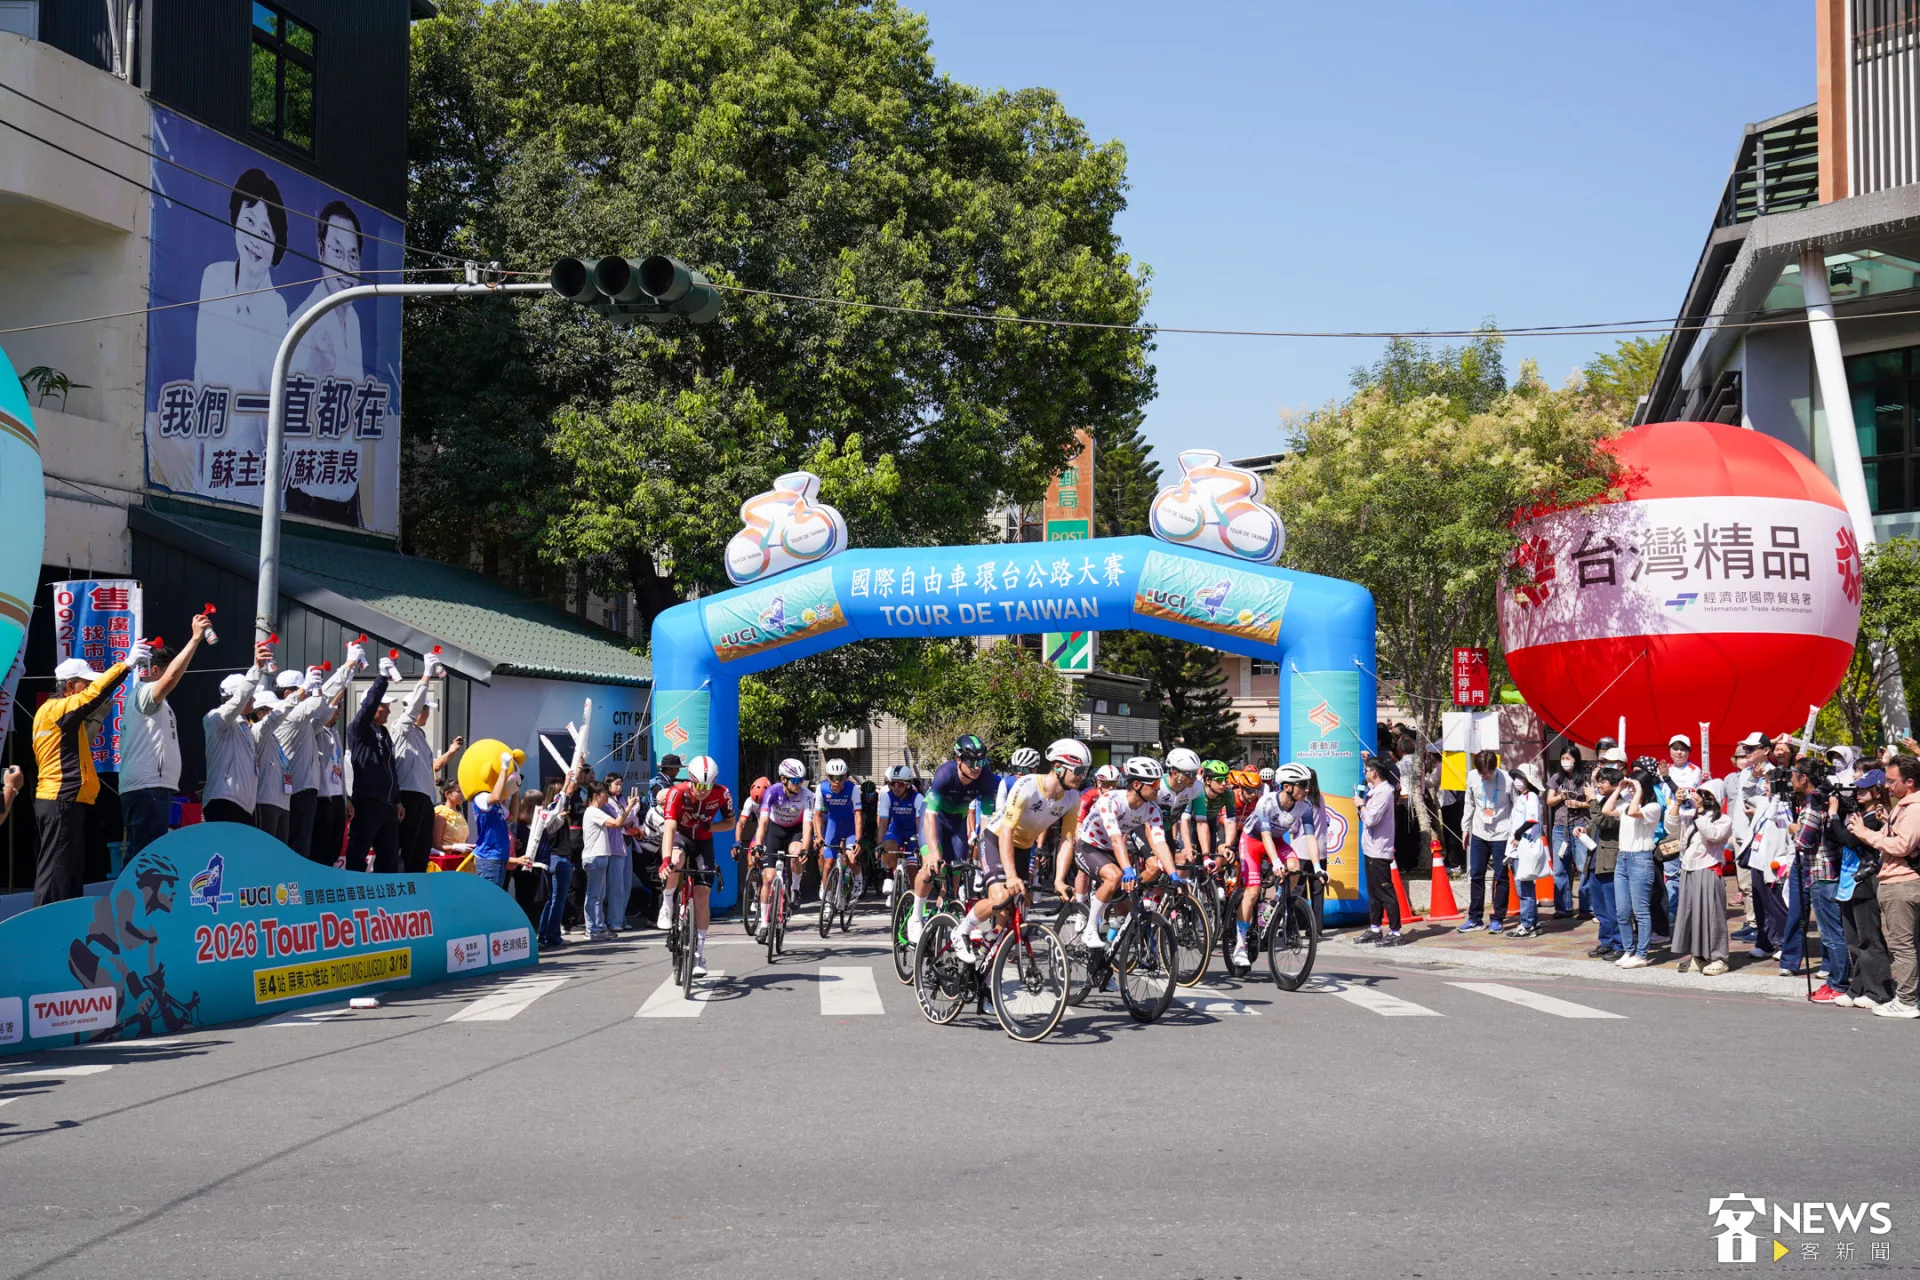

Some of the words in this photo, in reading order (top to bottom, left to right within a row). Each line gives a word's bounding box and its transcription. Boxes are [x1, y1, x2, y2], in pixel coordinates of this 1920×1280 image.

[161, 375, 387, 438] 我們一直都在
[1571, 521, 1811, 588] 台灣精品
[851, 552, 1125, 599] 國際自由車環台公路大賽
[90, 587, 129, 610] 售
[880, 604, 952, 626] TOUR
[959, 602, 994, 624] DE
[999, 597, 1100, 622] TAIWAN
[1153, 589, 1186, 609] UCI
[1704, 605, 1749, 613] International
[1751, 605, 1769, 613] Trade
[1771, 606, 1813, 614] Administration
[726, 626, 758, 647] UCI
[1457, 651, 1470, 703] 禁止停車
[613, 711, 633, 726] CITY
[246, 887, 271, 906] UCI
[196, 921, 257, 963] 2026
[261, 918, 318, 956] Tour
[321, 912, 355, 949] De
[353, 908, 433, 945] Taiwan
[259, 975, 286, 997] 第4站
[288, 968, 329, 992] 屏東六堆站
[331, 961, 364, 985] PINGTUNG
[389, 954, 408, 973] 3/18
[34, 995, 112, 1020] TAIWAN
